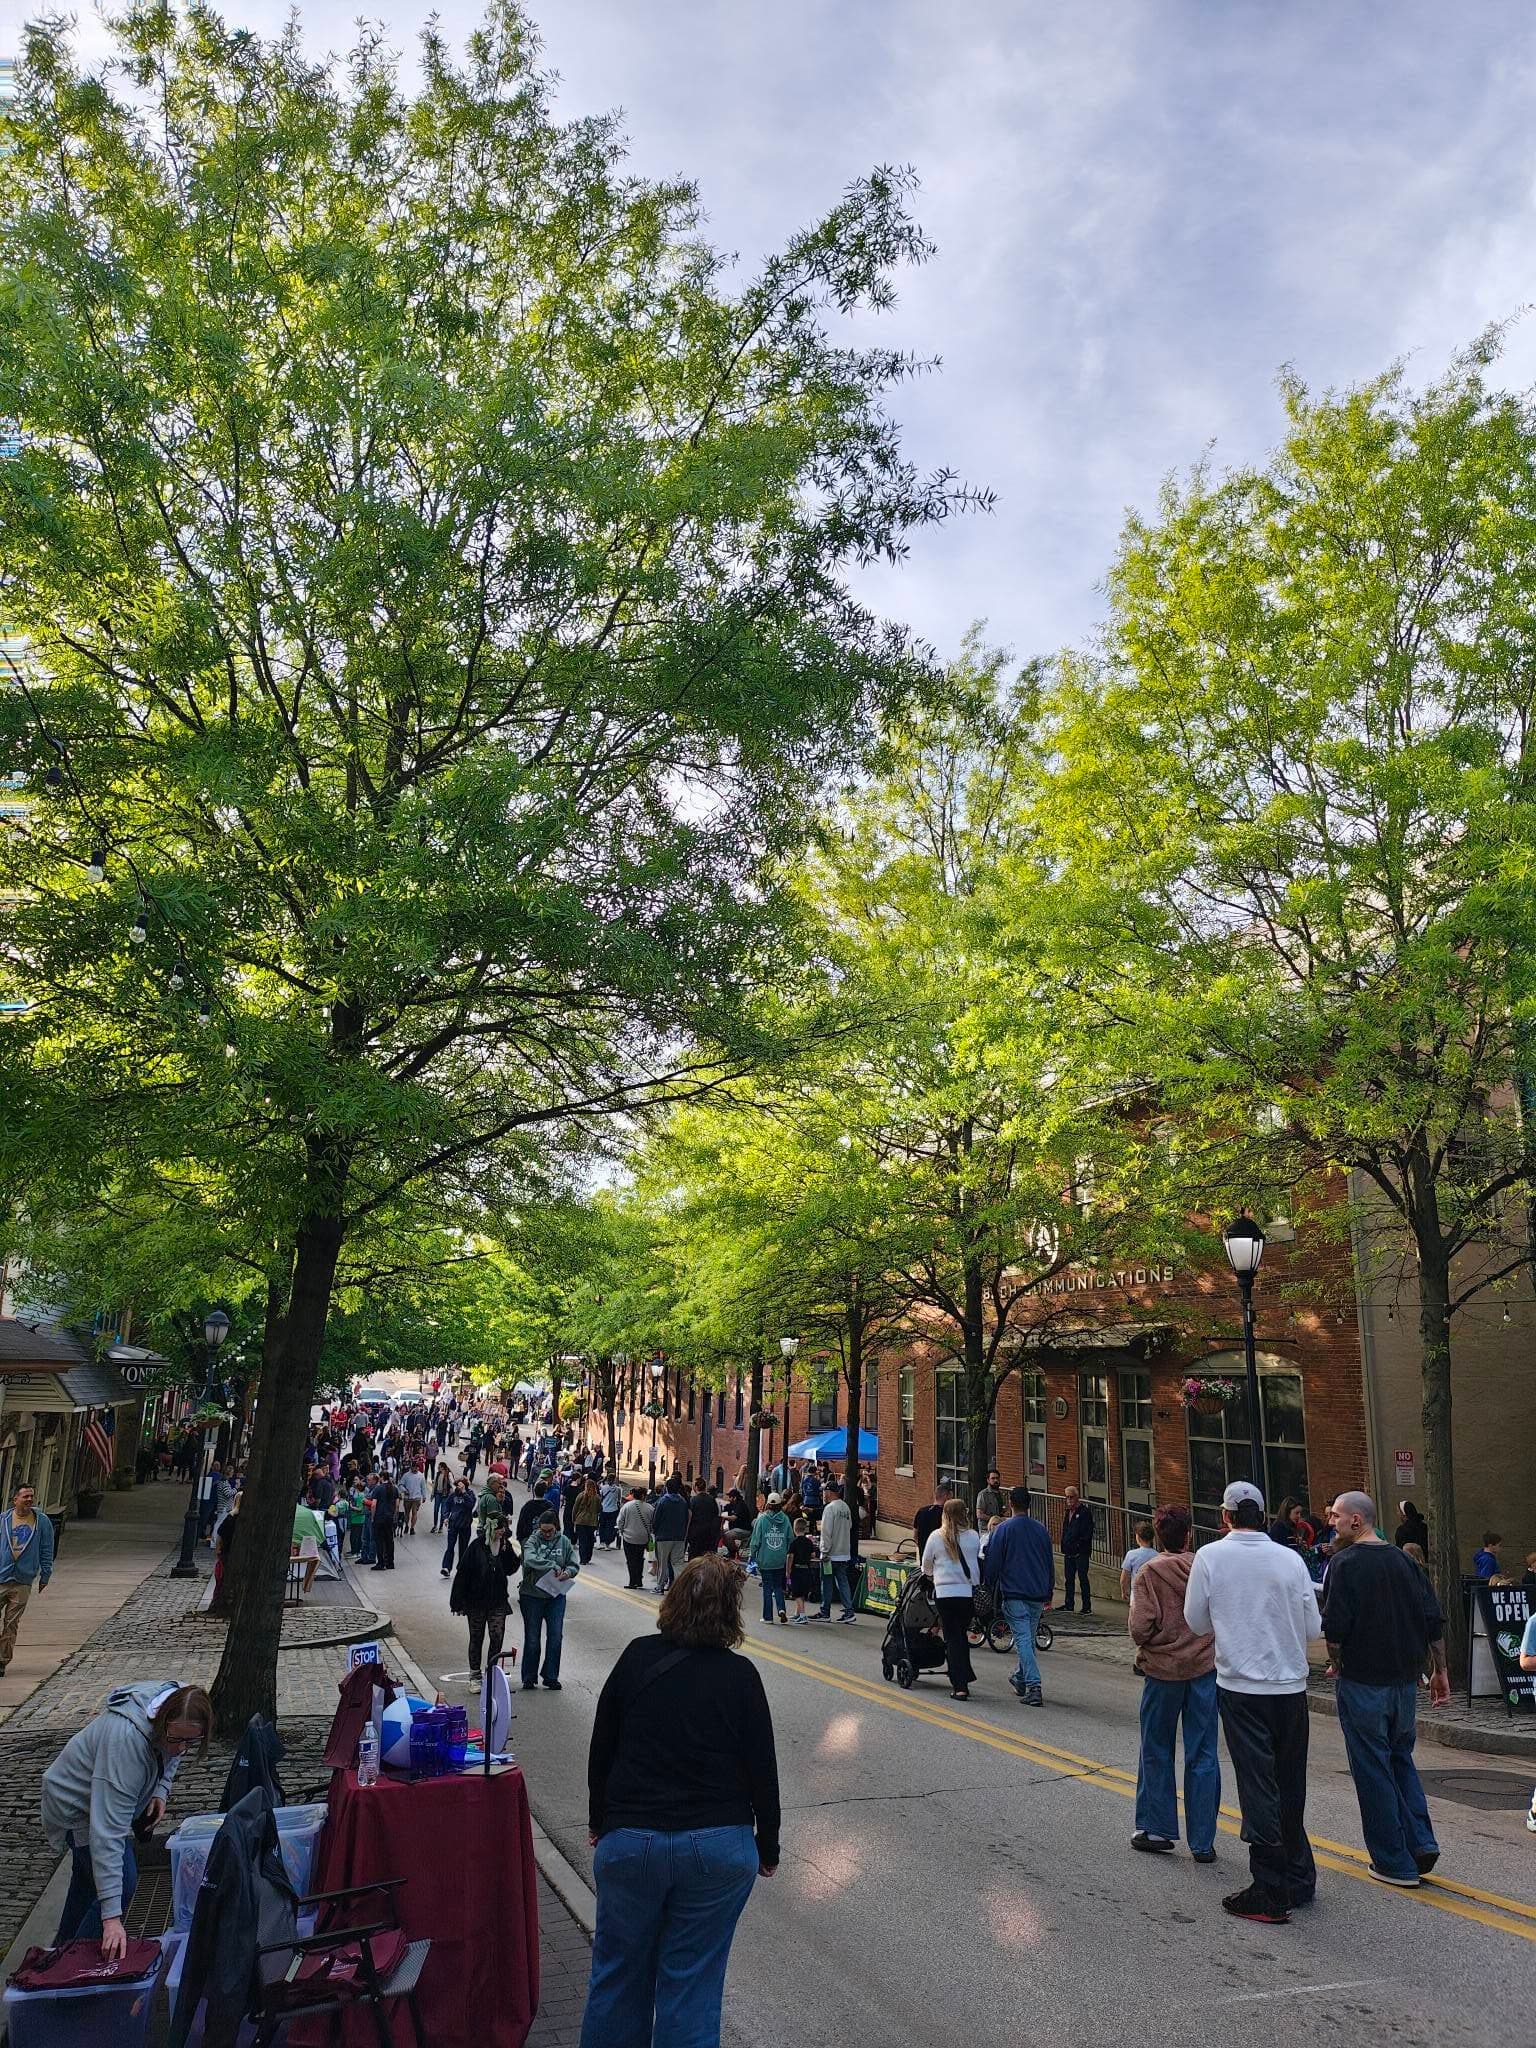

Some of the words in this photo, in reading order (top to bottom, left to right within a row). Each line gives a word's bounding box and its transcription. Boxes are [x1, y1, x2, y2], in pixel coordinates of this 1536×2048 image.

[1398, 1452, 1411, 1461] NO
[1491, 1591, 1506, 1604] WE
[1509, 1591, 1527, 1603] ARE
[1495, 1603, 1530, 1622] OPEN
[354, 1649, 376, 1665] STOP
